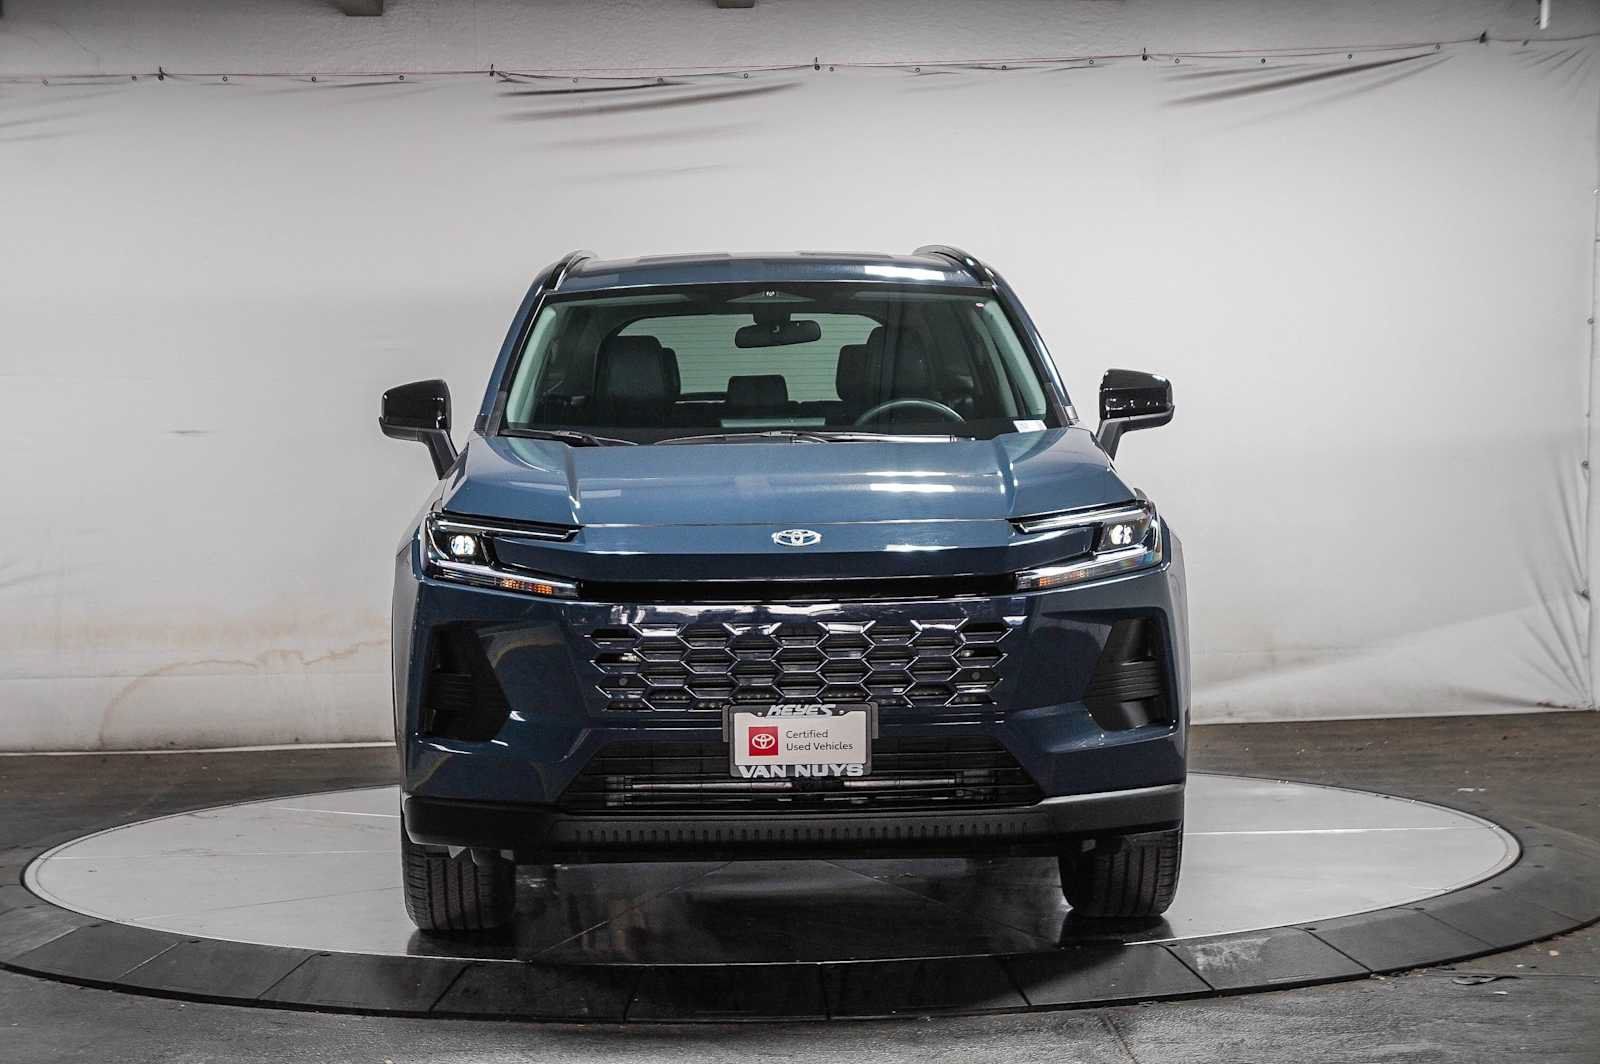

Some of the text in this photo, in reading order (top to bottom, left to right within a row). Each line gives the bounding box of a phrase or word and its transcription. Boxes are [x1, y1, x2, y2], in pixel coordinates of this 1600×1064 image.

[766, 704, 836, 717] KEYES
[785, 729, 829, 739] Certified
[786, 741, 854, 751] Used Vehicles
[738, 764, 864, 778] VAN NUYS
